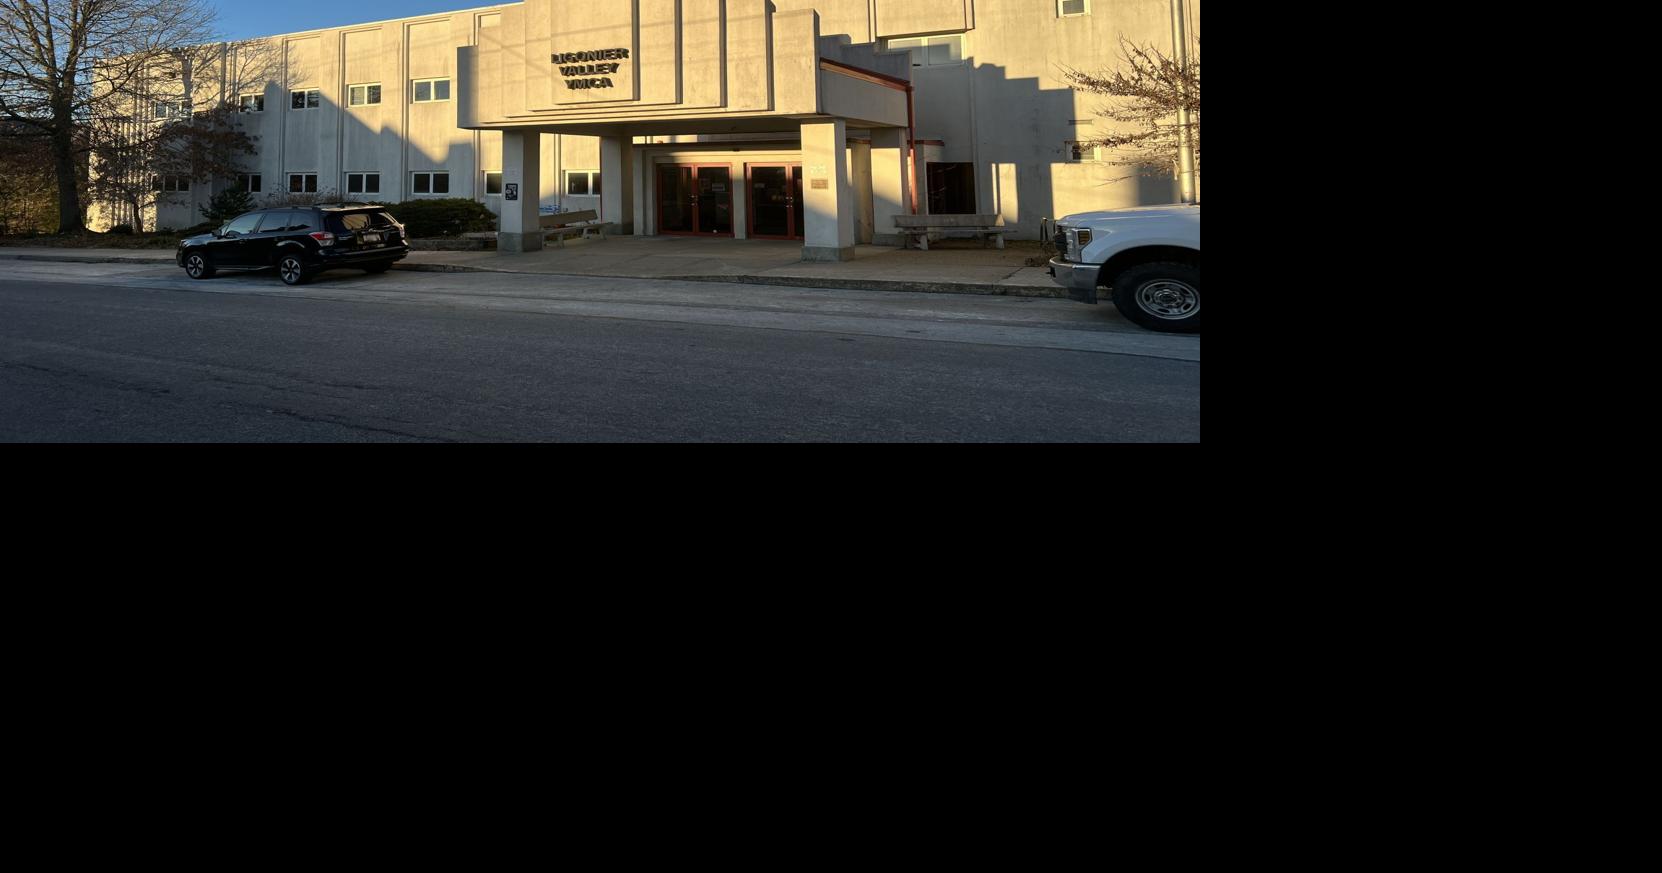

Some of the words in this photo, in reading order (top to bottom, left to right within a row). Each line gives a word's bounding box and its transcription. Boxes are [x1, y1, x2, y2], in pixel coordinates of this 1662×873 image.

[551, 47, 629, 64] LIGONIER
[559, 62, 619, 77] VALLEY
[564, 77, 613, 90] YMCA
